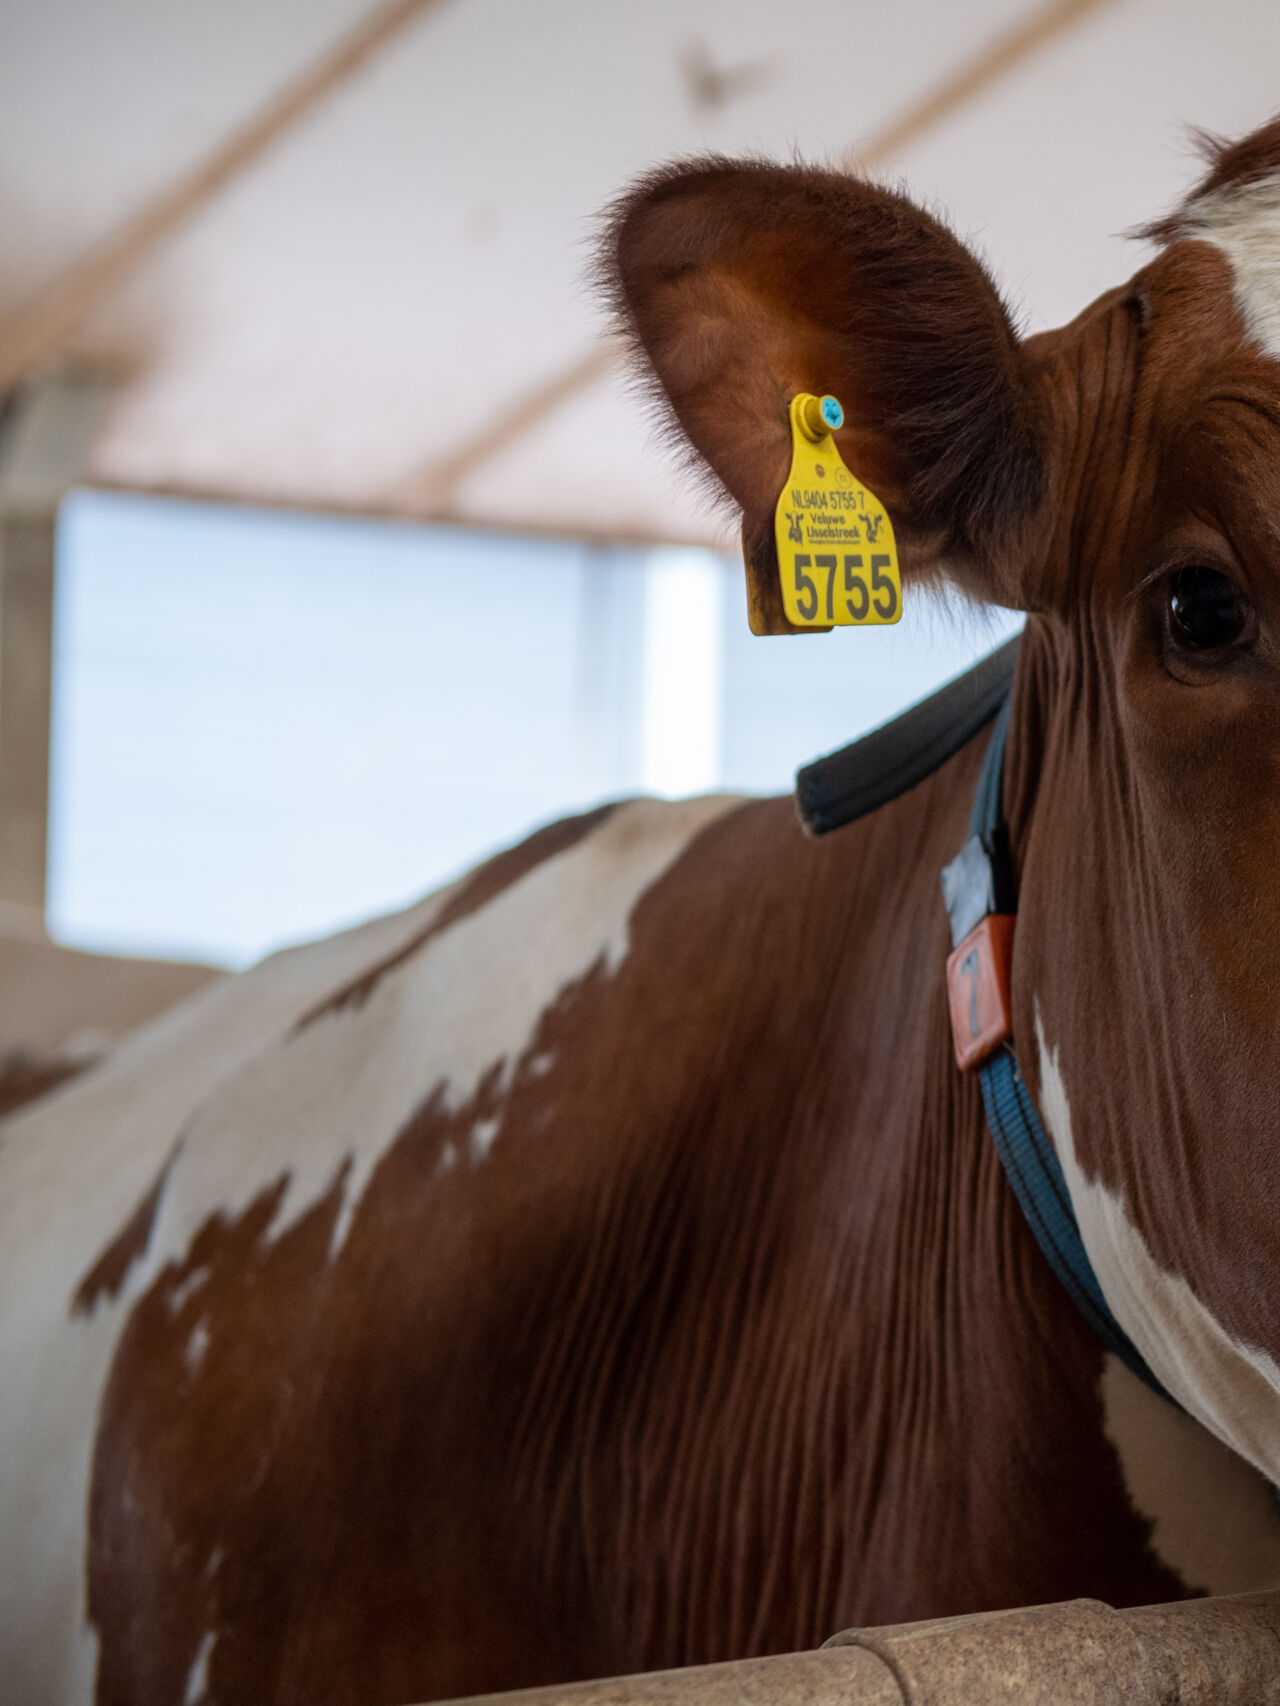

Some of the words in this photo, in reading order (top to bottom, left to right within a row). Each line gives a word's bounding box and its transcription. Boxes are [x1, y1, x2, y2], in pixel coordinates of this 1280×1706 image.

[792, 490, 827, 509] NL9404
[829, 491, 856, 509] 5755
[858, 491, 864, 509] 7
[810, 512, 846, 524] Veluwe
[794, 554, 897, 621] 5755
